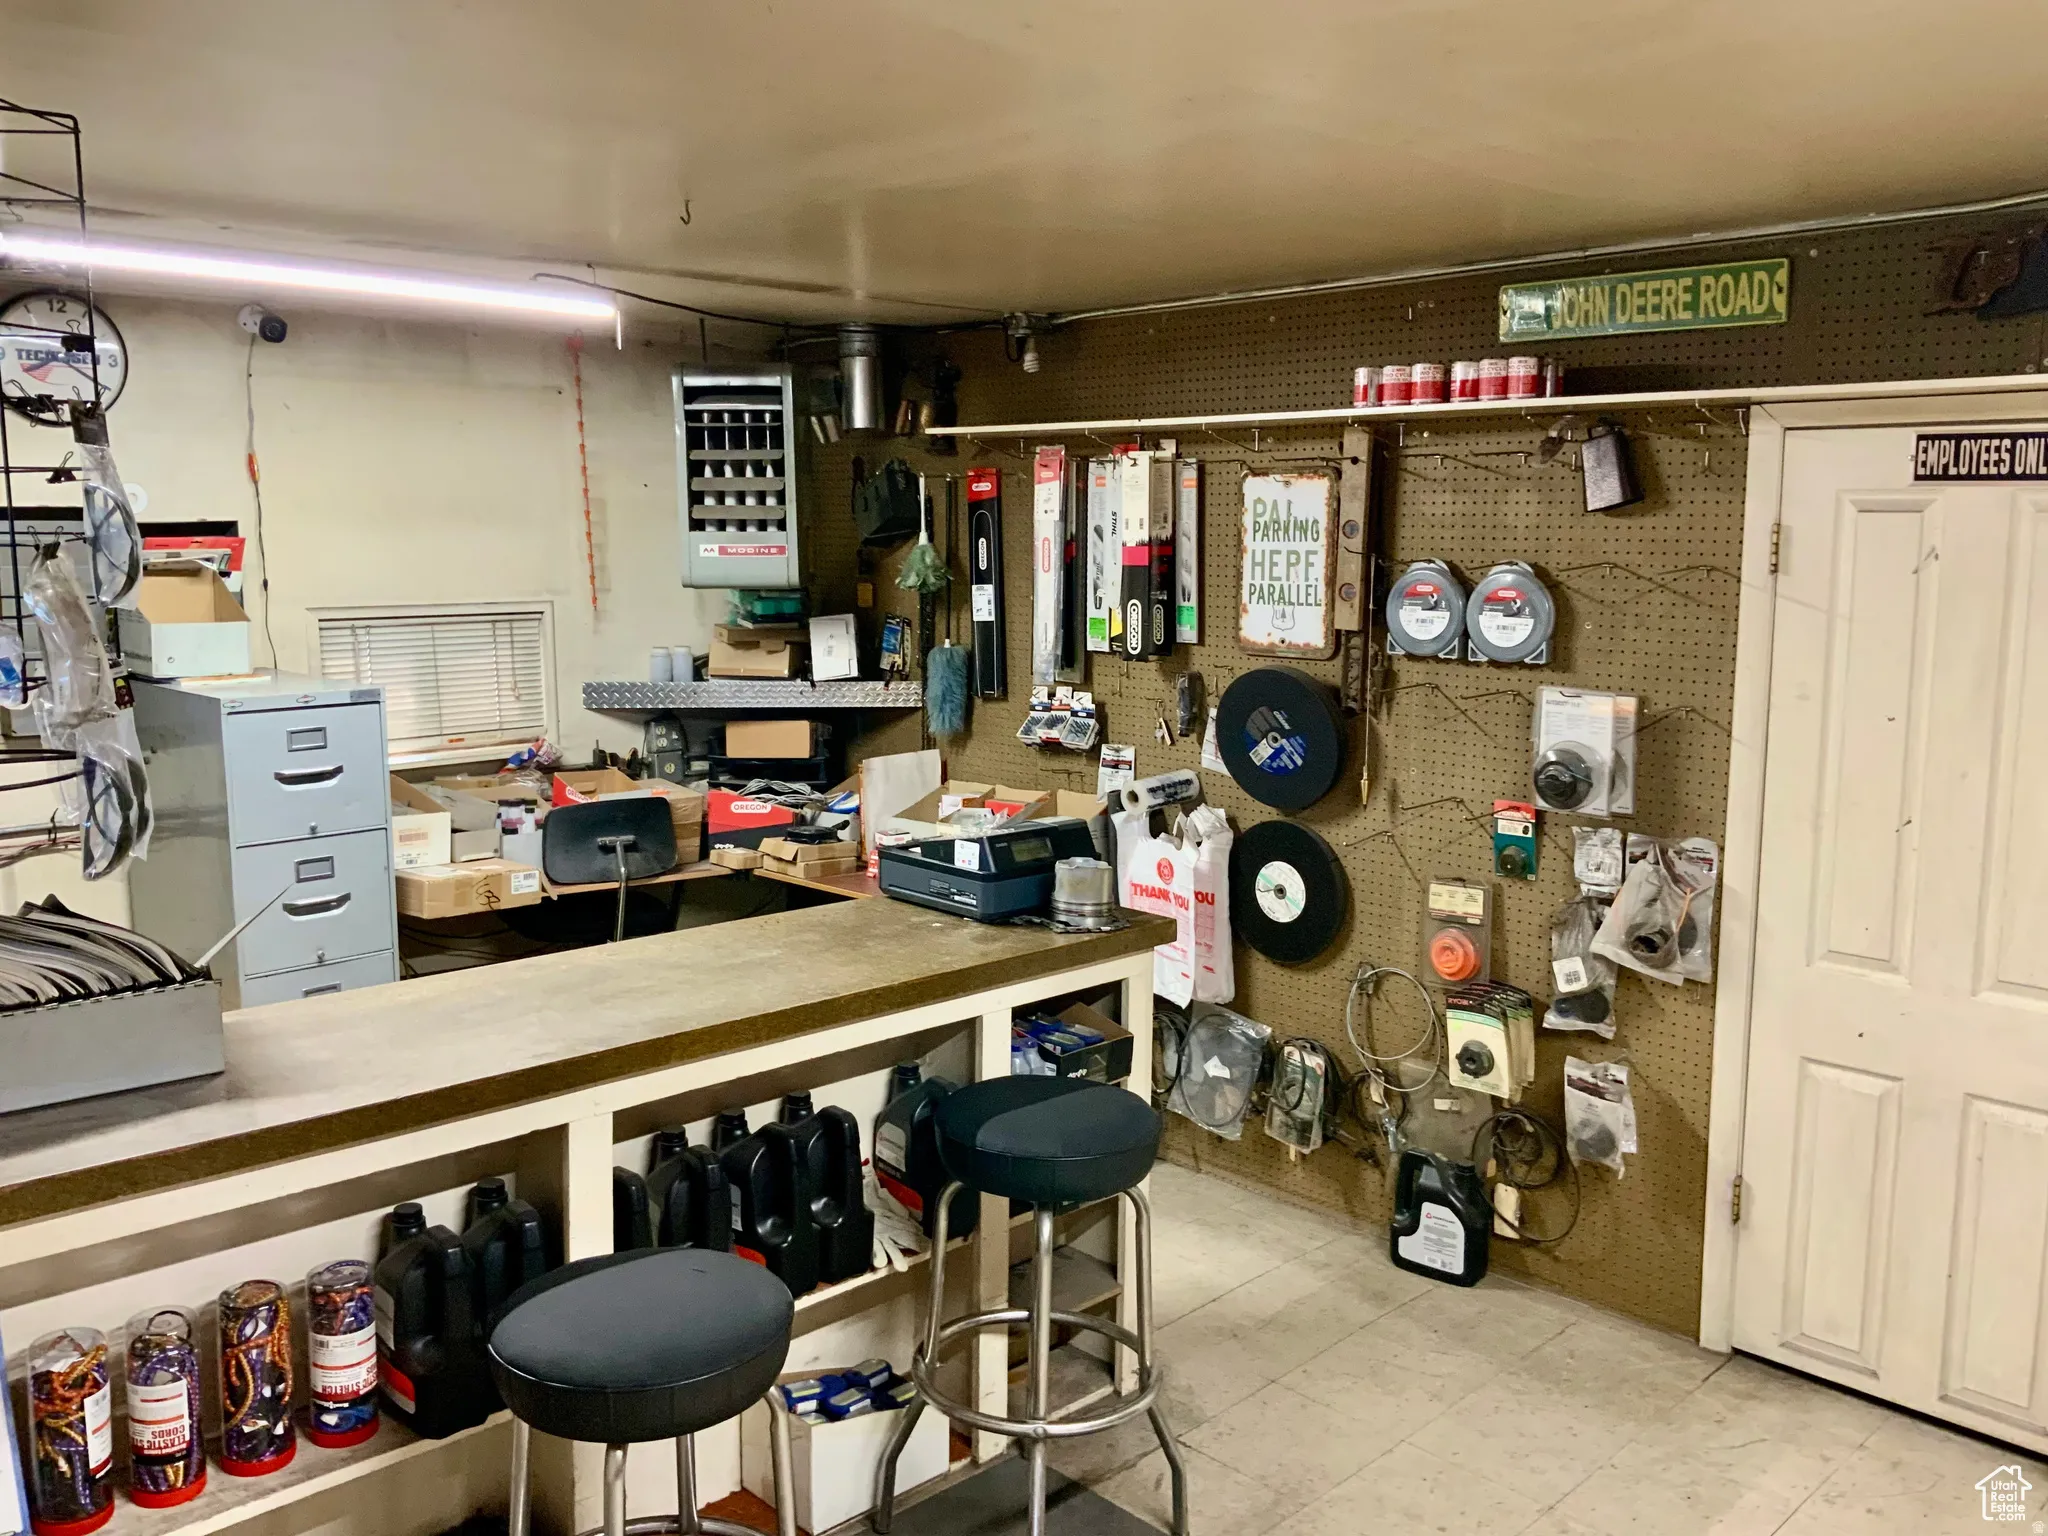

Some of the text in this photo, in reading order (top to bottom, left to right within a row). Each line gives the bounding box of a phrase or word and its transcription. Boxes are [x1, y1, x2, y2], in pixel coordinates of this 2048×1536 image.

[47, 299, 67, 313] 12
[1552, 270, 1769, 329] JOHN DEERE ROAD
[108, 354, 118, 368] 3
[1916, 437, 2048, 475] EMPLOYEES ONL
[1252, 519, 1320, 542] PARKING
[1248, 573, 1322, 607] PARALLEL
[1130, 604, 1139, 649] OREGON
[733, 803, 768, 812] OREGON
[1131, 883, 1190, 911] THANK YOU
[321, 1381, 361, 1395] STRETCH
[146, 1433, 187, 1449] ELASTIC
[151, 1425, 186, 1440] CORDS
